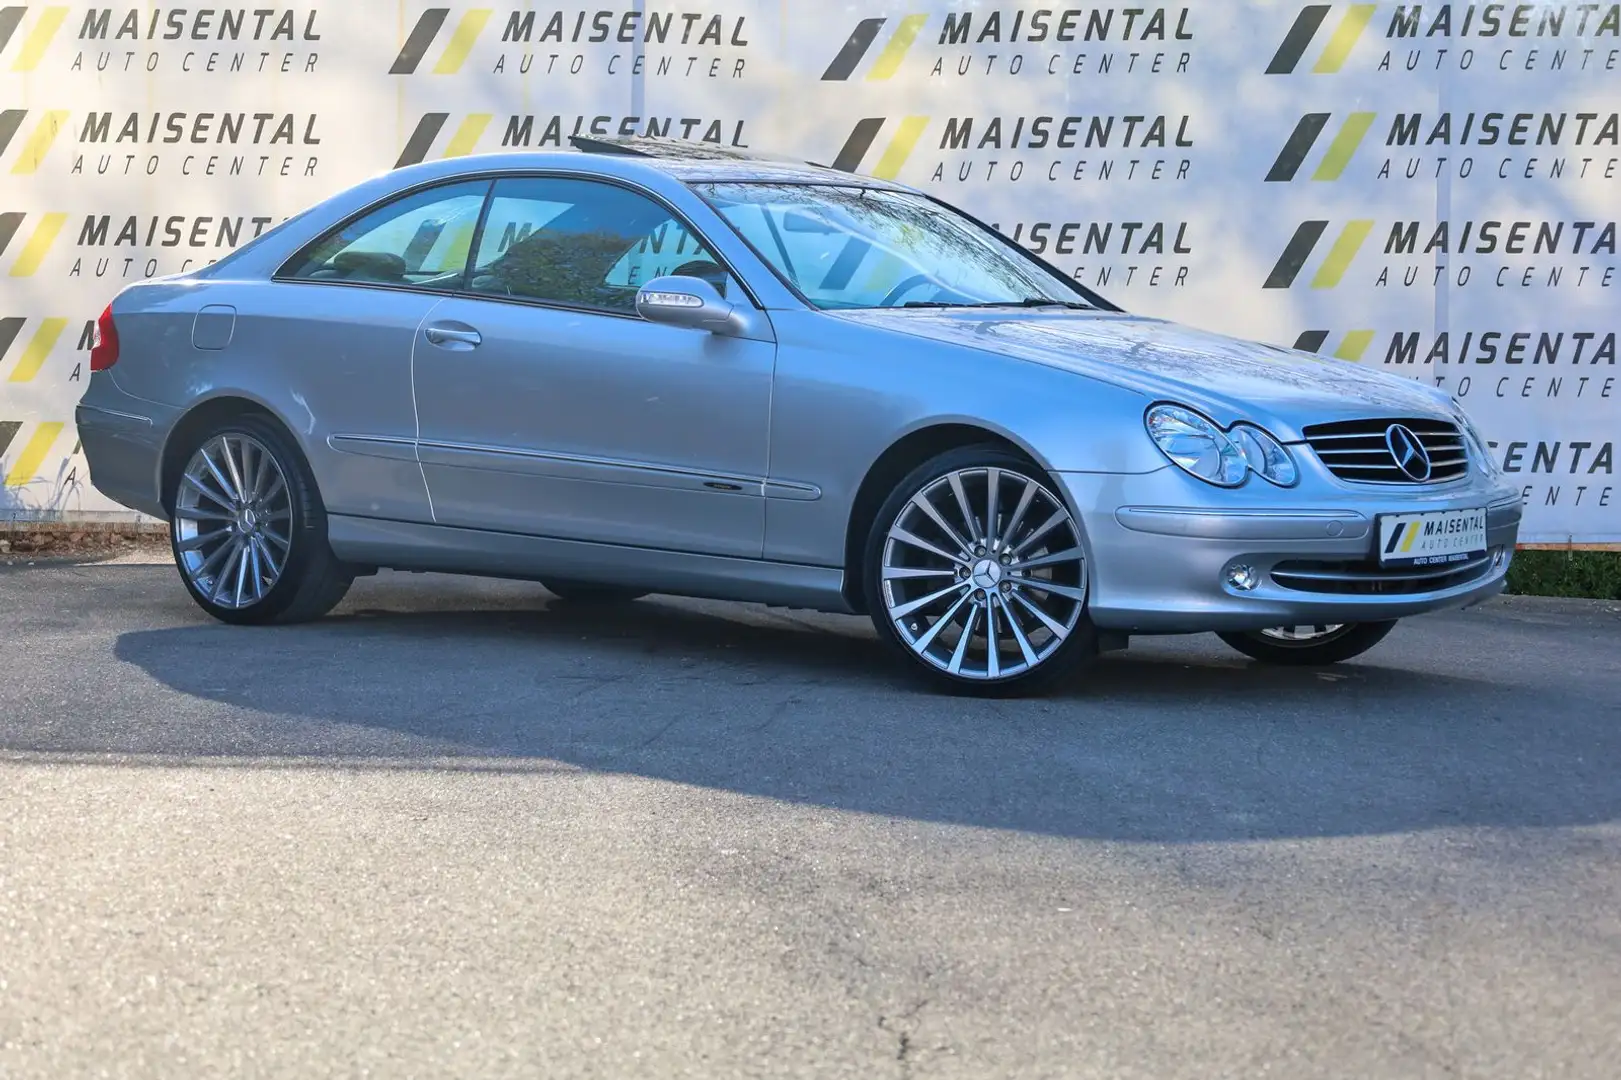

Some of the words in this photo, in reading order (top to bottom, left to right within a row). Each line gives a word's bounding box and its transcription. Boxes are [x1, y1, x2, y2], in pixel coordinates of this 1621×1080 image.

[78, 8, 321, 41] MAISENTAL
[501, 11, 748, 47] MAISENTAL
[938, 7, 1194, 45] MAISENTAL
[1386, 4, 1620, 38] MAISENTA
[71, 51, 159, 72] AUTO
[182, 51, 319, 73] CENTER
[493, 54, 584, 75] AUTO
[607, 54, 746, 79] CENTER
[931, 54, 1024, 77] AUTO
[1047, 52, 1191, 75] CENTER
[1377, 49, 1473, 72] AUTO
[1499, 49, 1620, 71] CENTE
[79, 112, 321, 145] MAISENTAL
[939, 115, 1194, 150] MAISENTAL
[1385, 112, 1620, 146] MAISENTA
[71, 154, 159, 176] AUTO
[182, 155, 319, 177] CENTER
[931, 160, 1024, 182] AUTO
[1048, 159, 1191, 182] CENTER
[1377, 157, 1473, 180] AUTO
[1498, 157, 1619, 179] CENTE
[77, 215, 289, 248] MAISENT
[991, 221, 1192, 255] ISENTAL
[1383, 221, 1617, 255] MAISENTA
[69, 257, 158, 278] AUTO
[1375, 266, 1472, 288] AUTO
[1496, 266, 1616, 288] CENTE
[1383, 331, 1616, 365] MAISENTA
[1496, 376, 1616, 398] CENTE
[1488, 441, 1613, 474] ENTA
[1424, 516, 1483, 537] MAISENTAL
